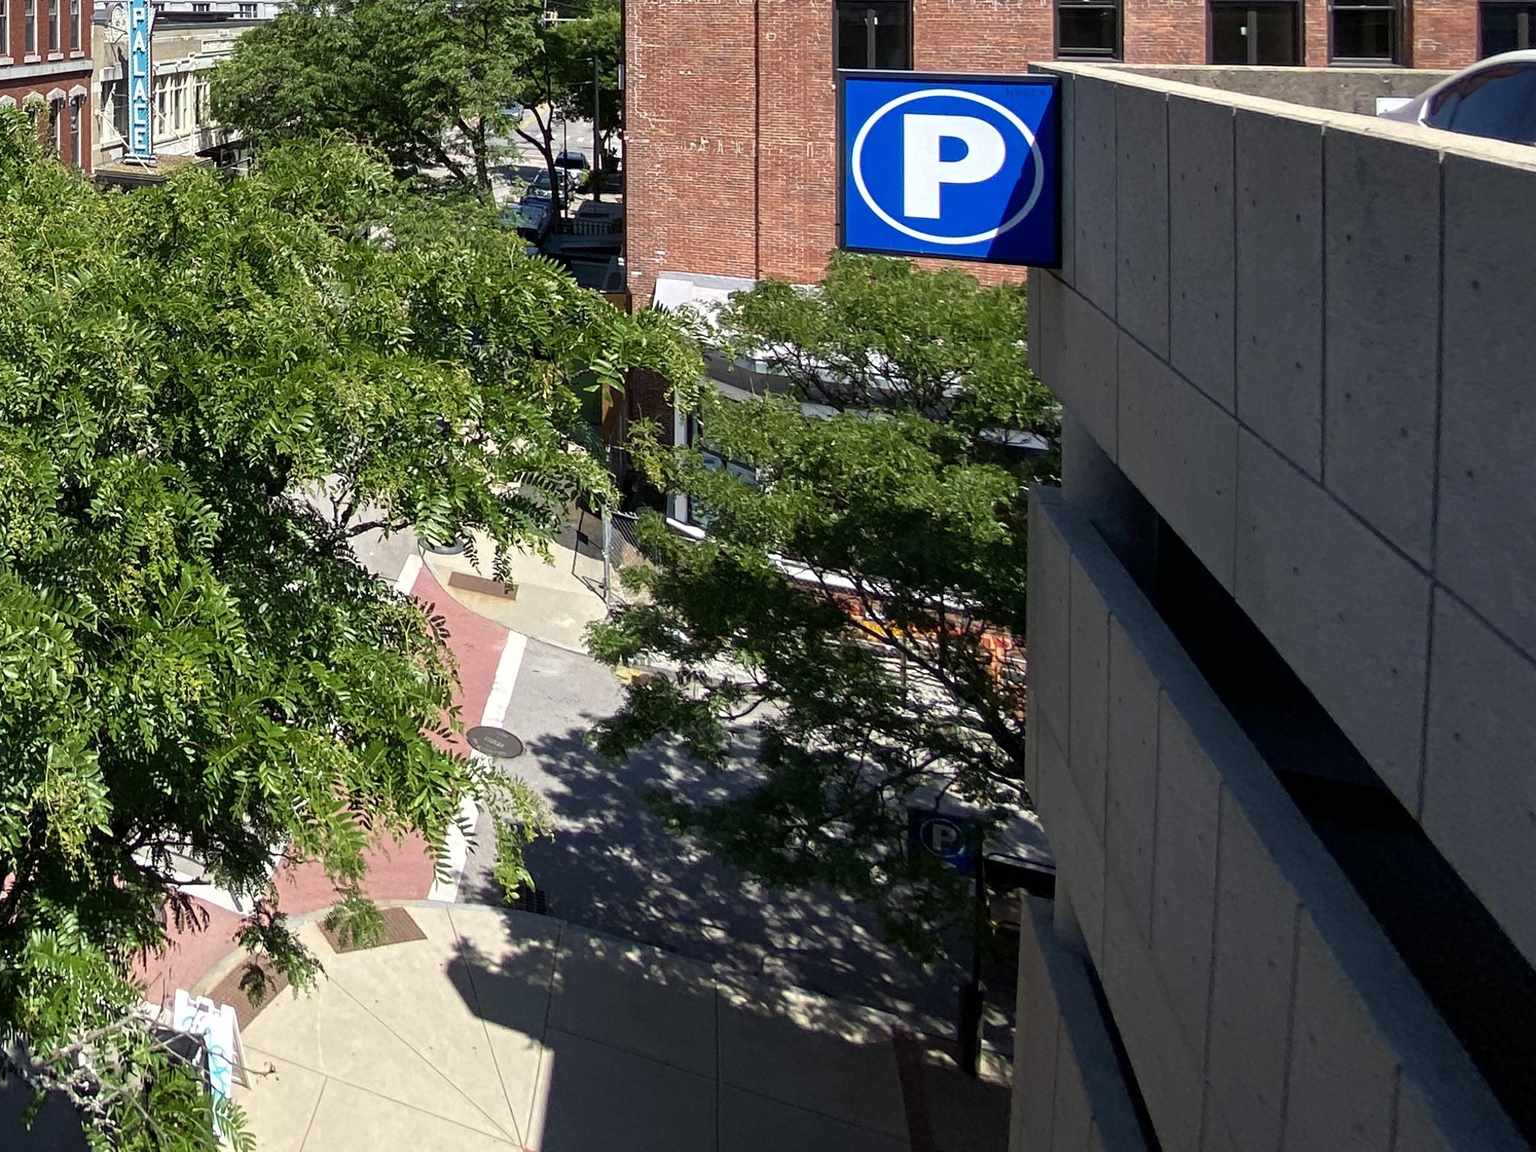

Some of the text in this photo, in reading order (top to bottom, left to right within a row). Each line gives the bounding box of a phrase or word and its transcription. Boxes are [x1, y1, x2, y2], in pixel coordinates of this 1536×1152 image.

[132, 7, 147, 149] PALACE
[904, 113, 1006, 219] P
[932, 823, 957, 851] P
